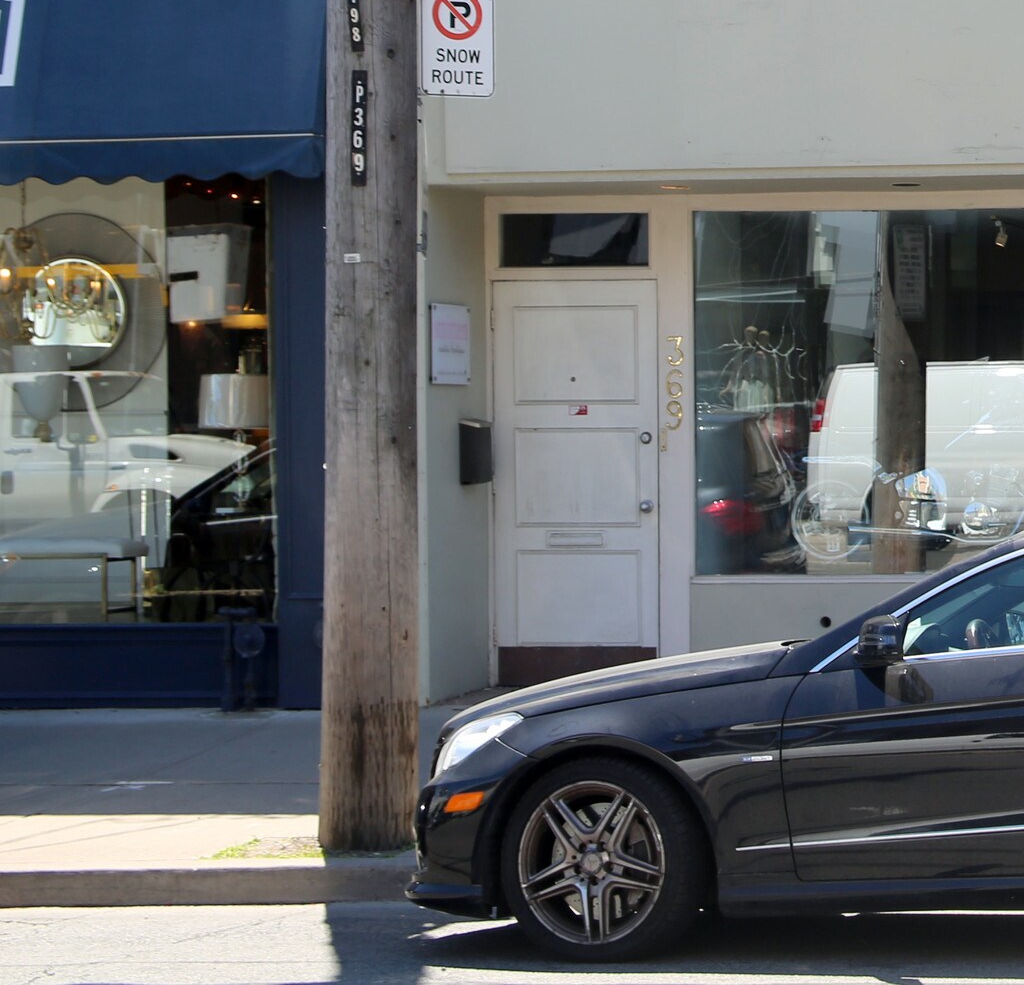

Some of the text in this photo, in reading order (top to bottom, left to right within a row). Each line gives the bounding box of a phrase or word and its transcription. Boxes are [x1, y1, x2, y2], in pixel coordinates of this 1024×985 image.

[432, 69, 484, 85] ROUTE
[436, 48, 480, 63] SNOW
[352, 85, 364, 172] P369
[666, 335, 684, 430] 369
